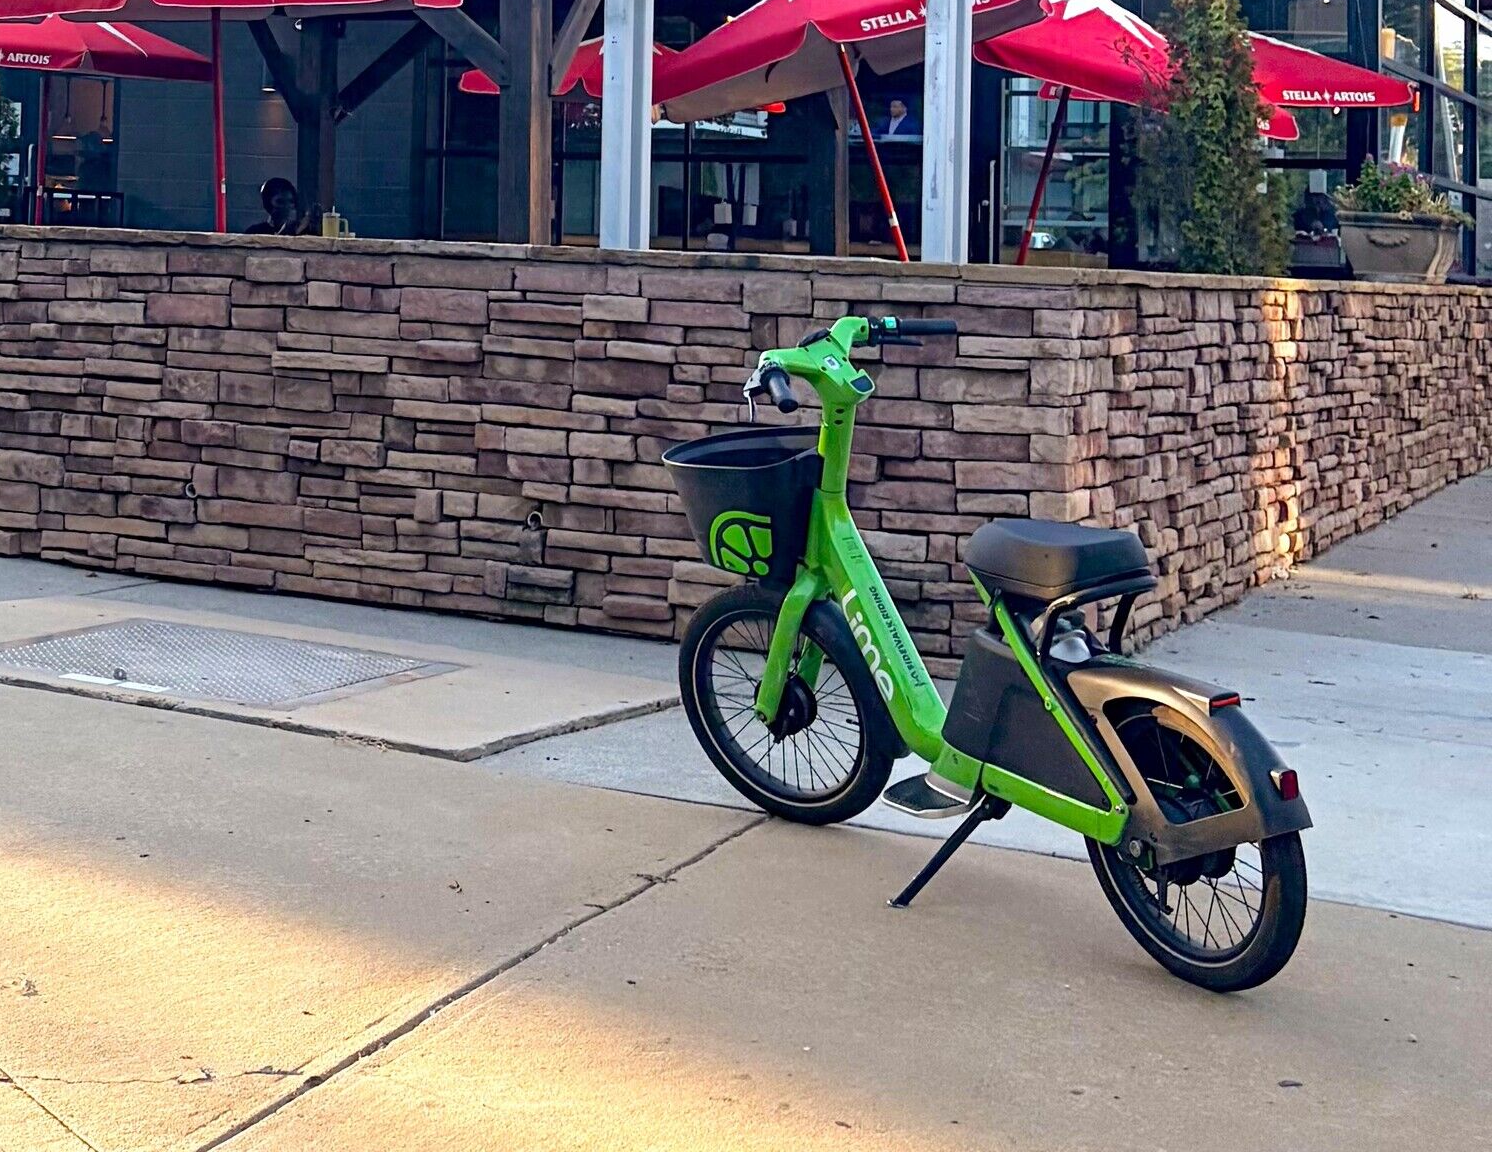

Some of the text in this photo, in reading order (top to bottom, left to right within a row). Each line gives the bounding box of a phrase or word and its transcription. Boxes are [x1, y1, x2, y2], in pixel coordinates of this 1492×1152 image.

[860, 9, 918, 31] STELLA
[7, 53, 50, 65] ARTOIS
[1282, 90, 1375, 102] STELLA ARTOIS
[841, 588, 894, 702] Lime
